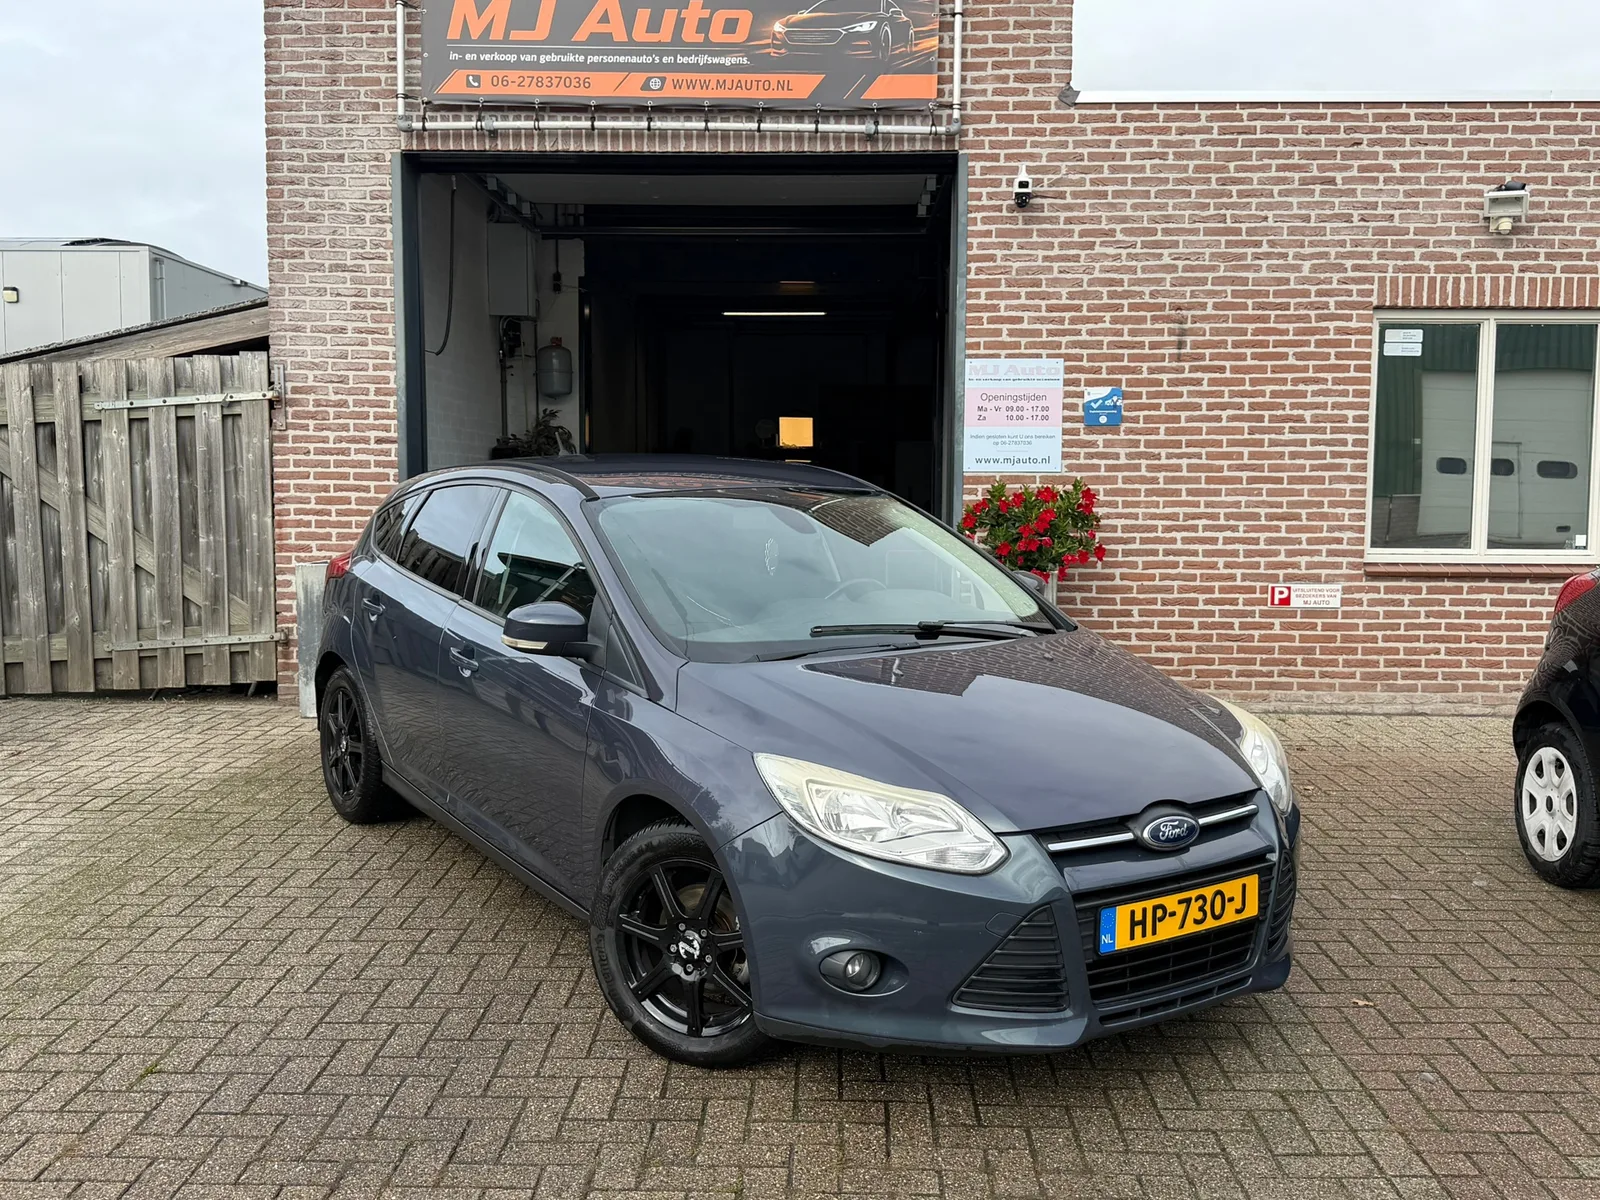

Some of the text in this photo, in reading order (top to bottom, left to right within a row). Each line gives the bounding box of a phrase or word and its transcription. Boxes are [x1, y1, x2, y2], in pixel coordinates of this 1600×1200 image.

[446, 0, 754, 43] MJ Auto
[449, 51, 751, 66] in- en verkoop van gebruikte personenauto's en bedrijfswagens.
[490, 75, 794, 91] 06-27837036 WWW.MJAUTO.NL
[968, 364, 1060, 376] MJ Auto
[980, 392, 1047, 403] Openingstijden
[974, 456, 1051, 466] www.mjauto.nl
[1273, 586, 1290, 605] P
[1159, 820, 1188, 841] Ford
[1129, 883, 1247, 941] HP-730-J
[1101, 934, 1114, 945] NL
